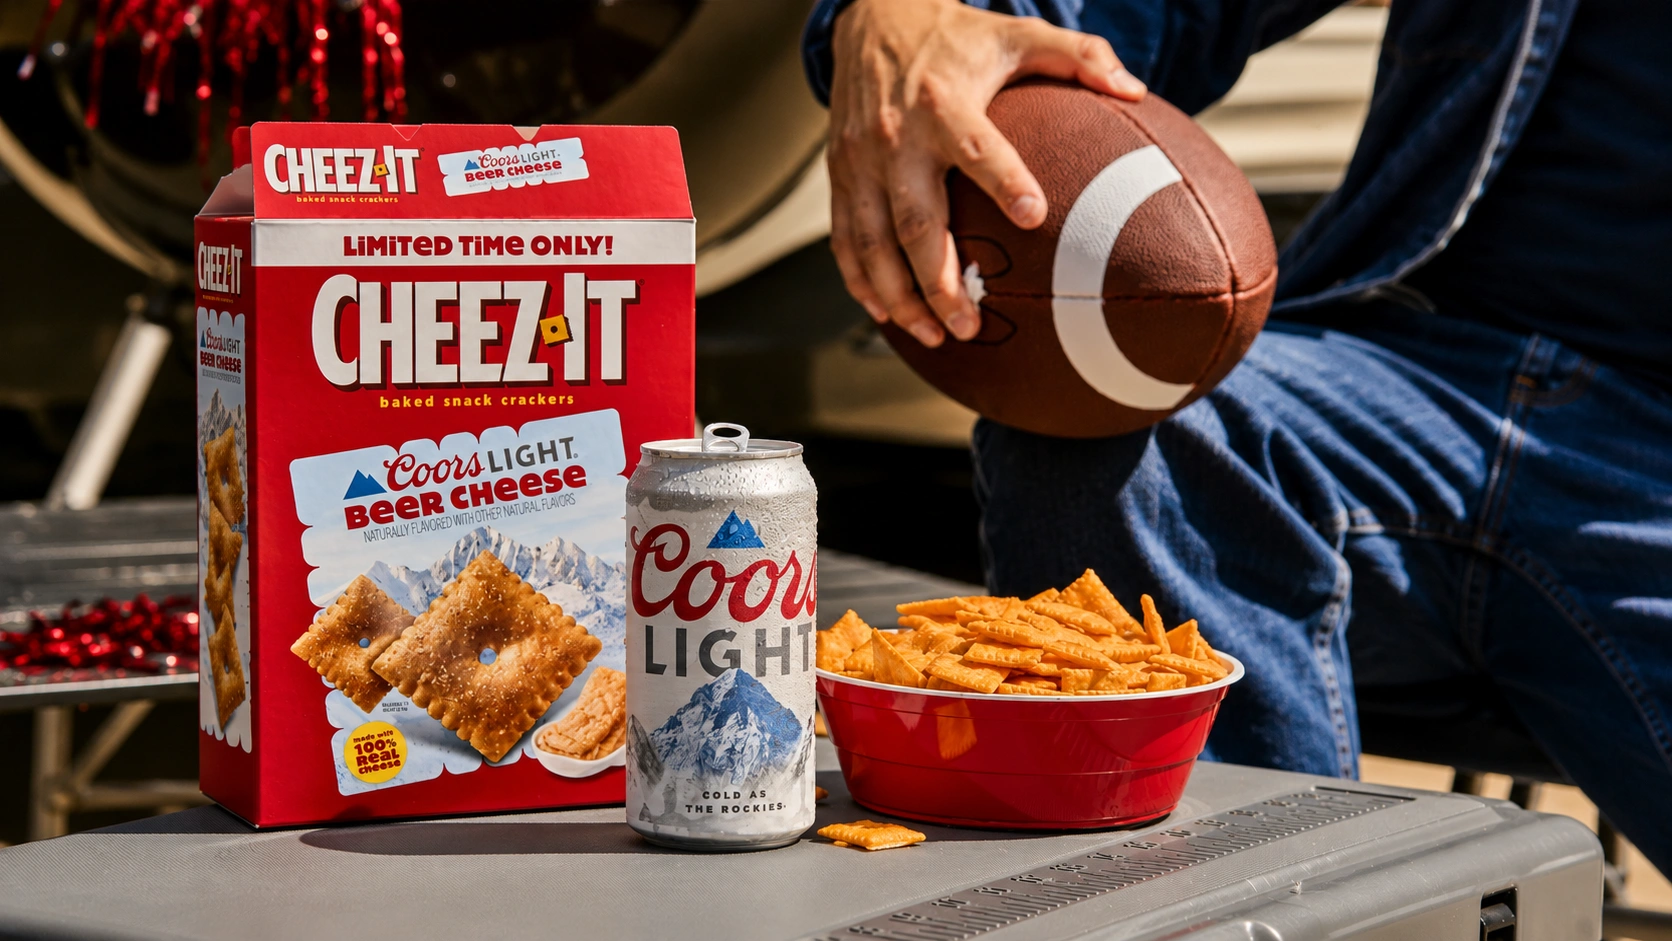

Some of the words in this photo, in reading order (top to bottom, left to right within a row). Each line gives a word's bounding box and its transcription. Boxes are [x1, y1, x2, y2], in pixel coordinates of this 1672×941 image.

[478, 153, 520, 169] Coors
[296, 195, 325, 203] baked
[329, 195, 356, 203] snack
[359, 195, 399, 203] crackers
[530, 234, 614, 256] ONLY!
[379, 395, 434, 408] baked
[443, 395, 492, 408] snack
[501, 394, 574, 407] crackers
[383, 451, 486, 492] Coors
[487, 436, 575, 473] LIGHT
[364, 524, 410, 543] NATURALLY
[410, 516, 453, 535] FLAVORED
[452, 512, 475, 527] WITH
[475, 506, 502, 523] OTHER
[502, 500, 541, 518] NATURAL
[541, 492, 577, 511] FLAVORS
[645, 621, 813, 678] LIGHT
[354, 739, 397, 755] 100%
[702, 791, 742, 801] COLD
[750, 790, 767, 799] AS
[685, 804, 714, 814] THE
